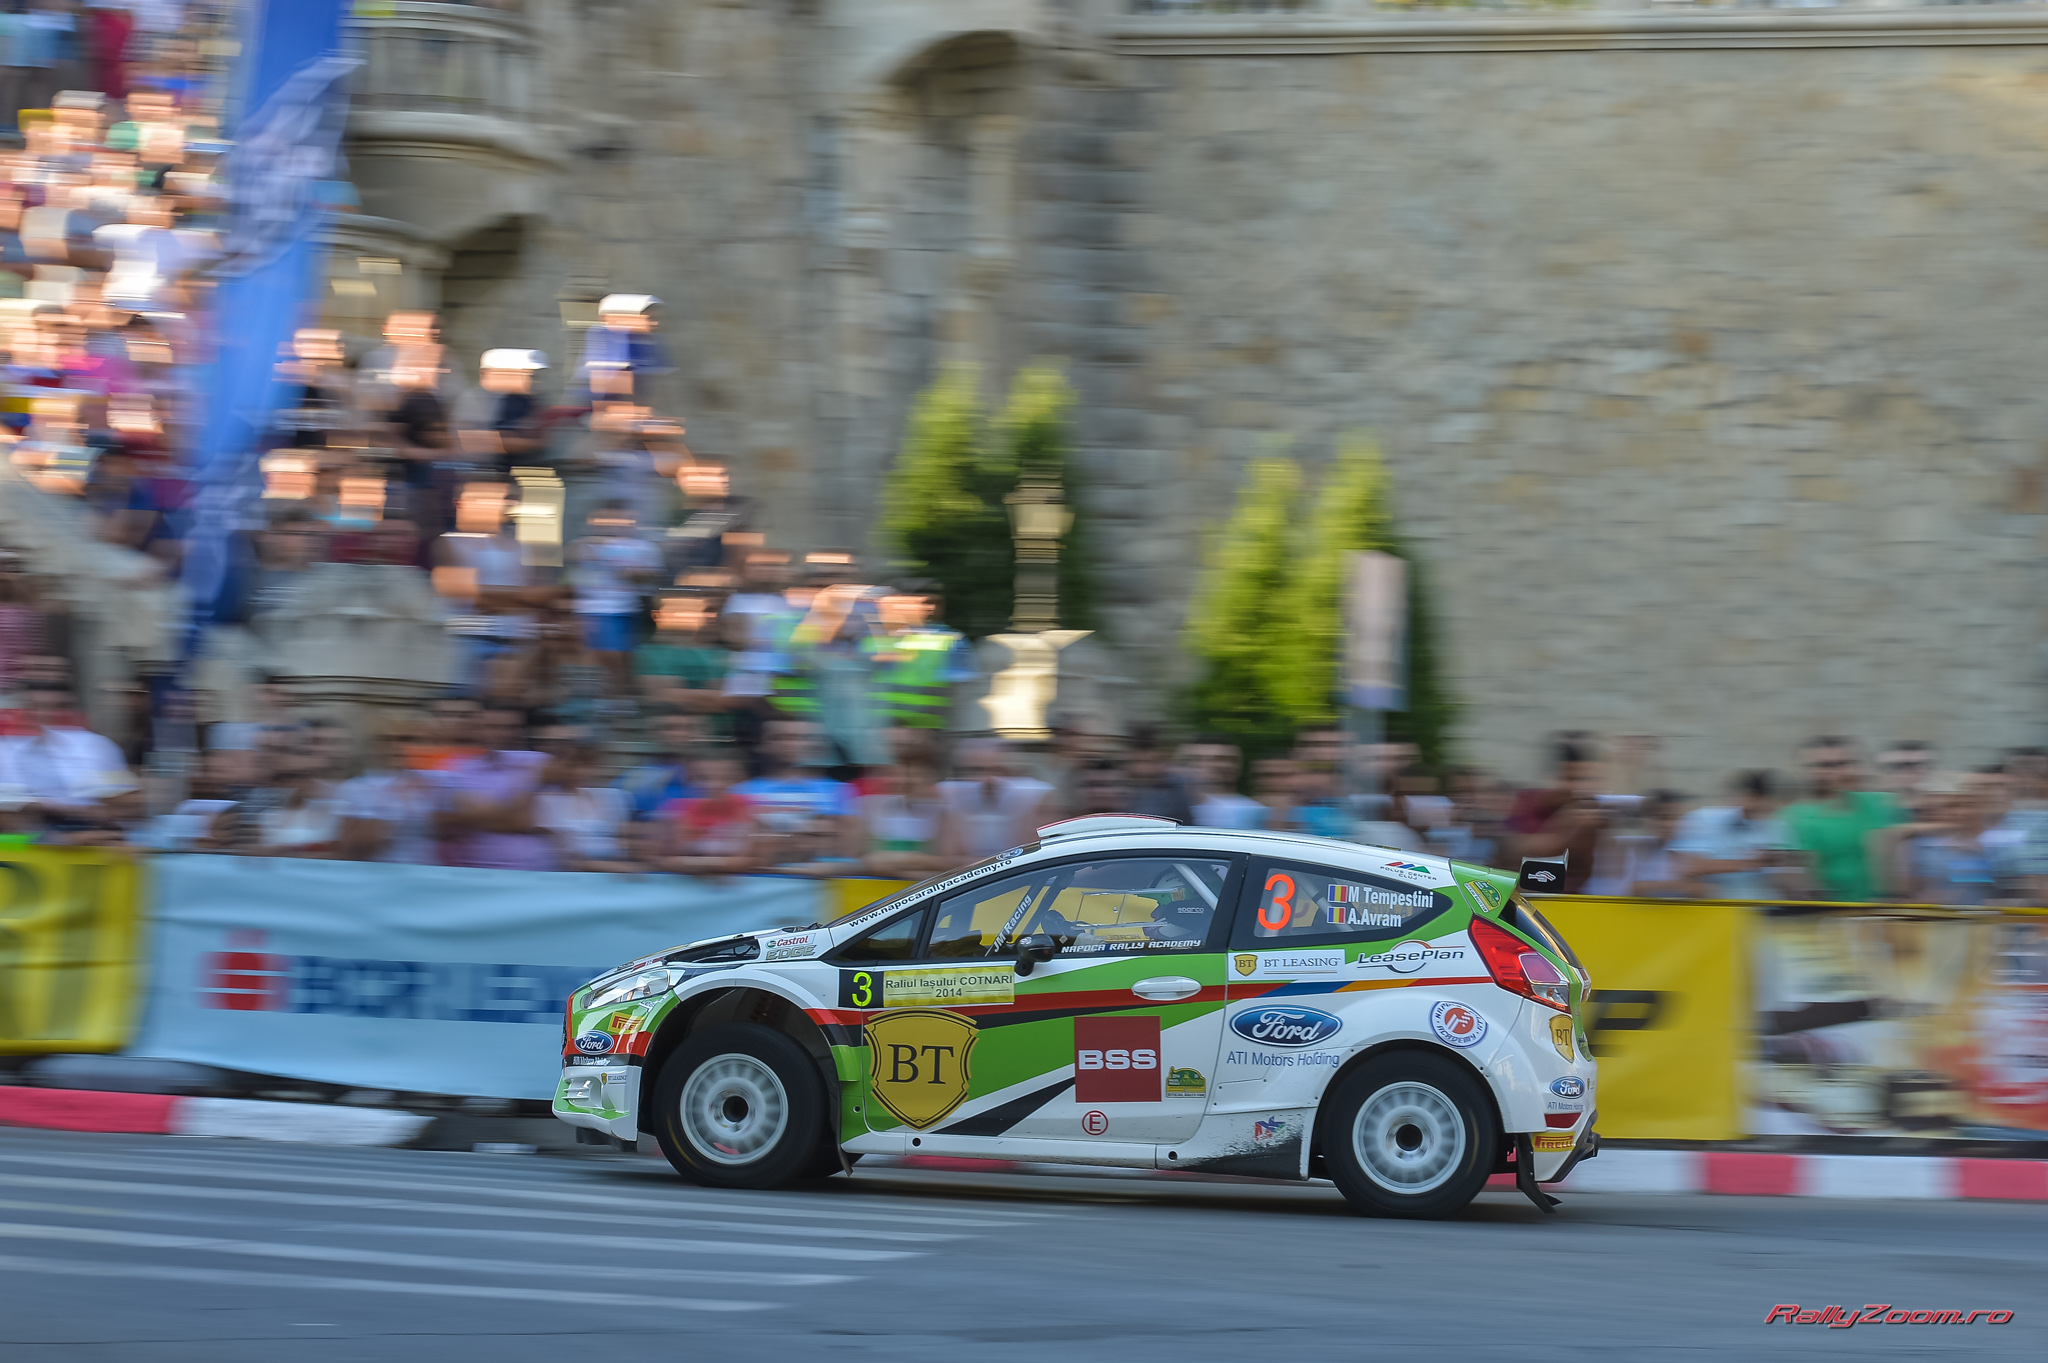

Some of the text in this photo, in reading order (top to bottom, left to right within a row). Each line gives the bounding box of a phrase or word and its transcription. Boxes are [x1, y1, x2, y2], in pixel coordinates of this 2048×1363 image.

[849, 859, 1012, 928] www.napocarallyacademy.ro
[1257, 873, 1296, 931] 3
[1349, 886, 1434, 911] M Tempestini
[1005, 894, 1032, 935] Racing
[1348, 907, 1402, 927] A.Avram
[777, 935, 809, 947] Castrol
[1061, 939, 1201, 953] NAPOCA RALLY ACADEMY
[766, 944, 817, 960] EDGE
[1358, 949, 1464, 964] LeasePlan
[1239, 959, 1254, 968] BT
[1263, 957, 1339, 968] BT LEASING
[852, 971, 873, 1007] 3
[885, 978, 917, 989] Raliul
[959, 975, 1013, 986] COTNARI
[935, 988, 963, 998] 2014
[1251, 1010, 1323, 1042] Ford
[580, 1033, 605, 1050] Ford
[1555, 1028, 1570, 1046] BT
[886, 1043, 955, 1085] BT
[1078, 1048, 1157, 1070] BSS
[1226, 1050, 1340, 1069] ATI Motors Holding
[1560, 1080, 1580, 1095] Ford
[1535, 1135, 1574, 1149] PIRELLI
